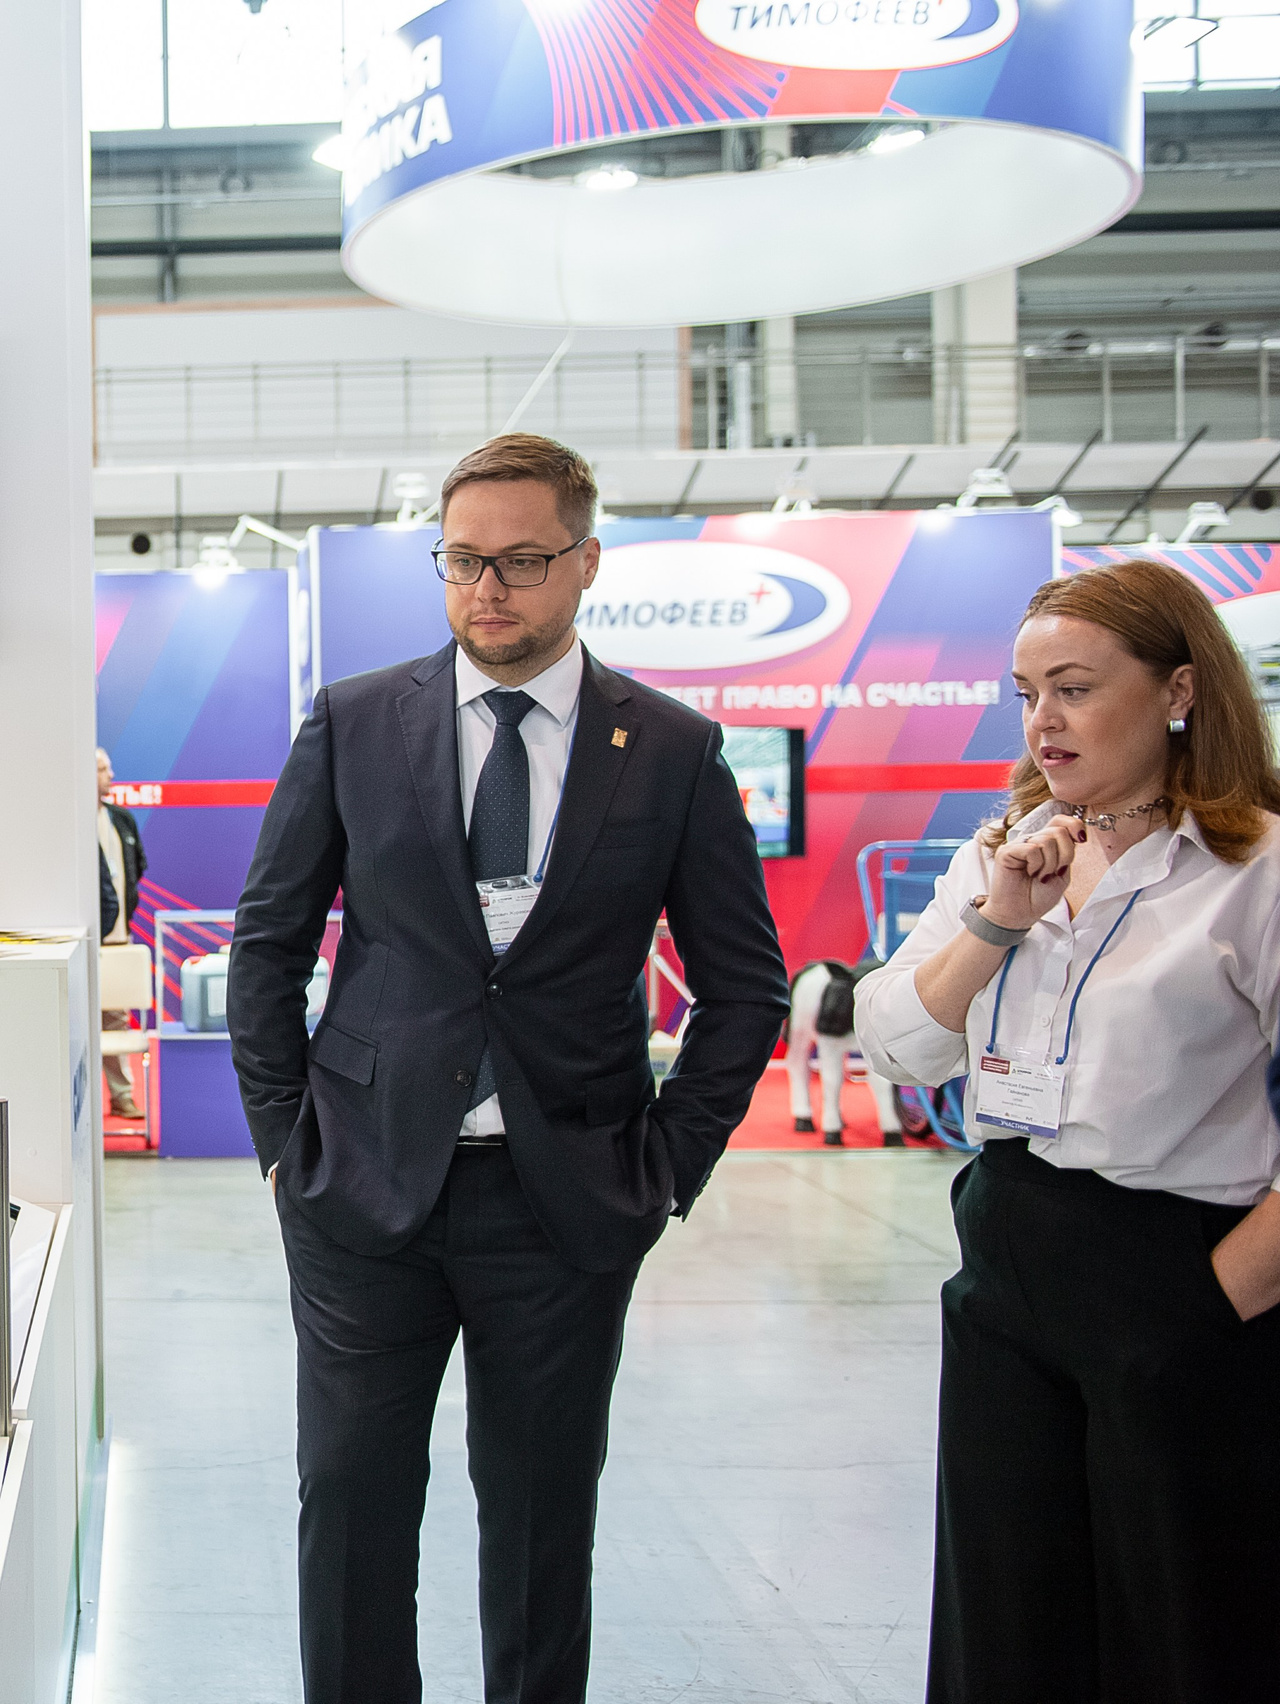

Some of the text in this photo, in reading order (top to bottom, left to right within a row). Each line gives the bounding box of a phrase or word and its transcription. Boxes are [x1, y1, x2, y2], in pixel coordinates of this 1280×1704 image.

[574, 600, 748, 629] ИМОФЕЕВ
[722, 684, 818, 709] ПРАВО
[822, 683, 863, 708] НА
[866, 680, 1000, 708] СЧАСТЬЕ!
[1000, 1120, 1030, 1132] УЧАСТНИК
